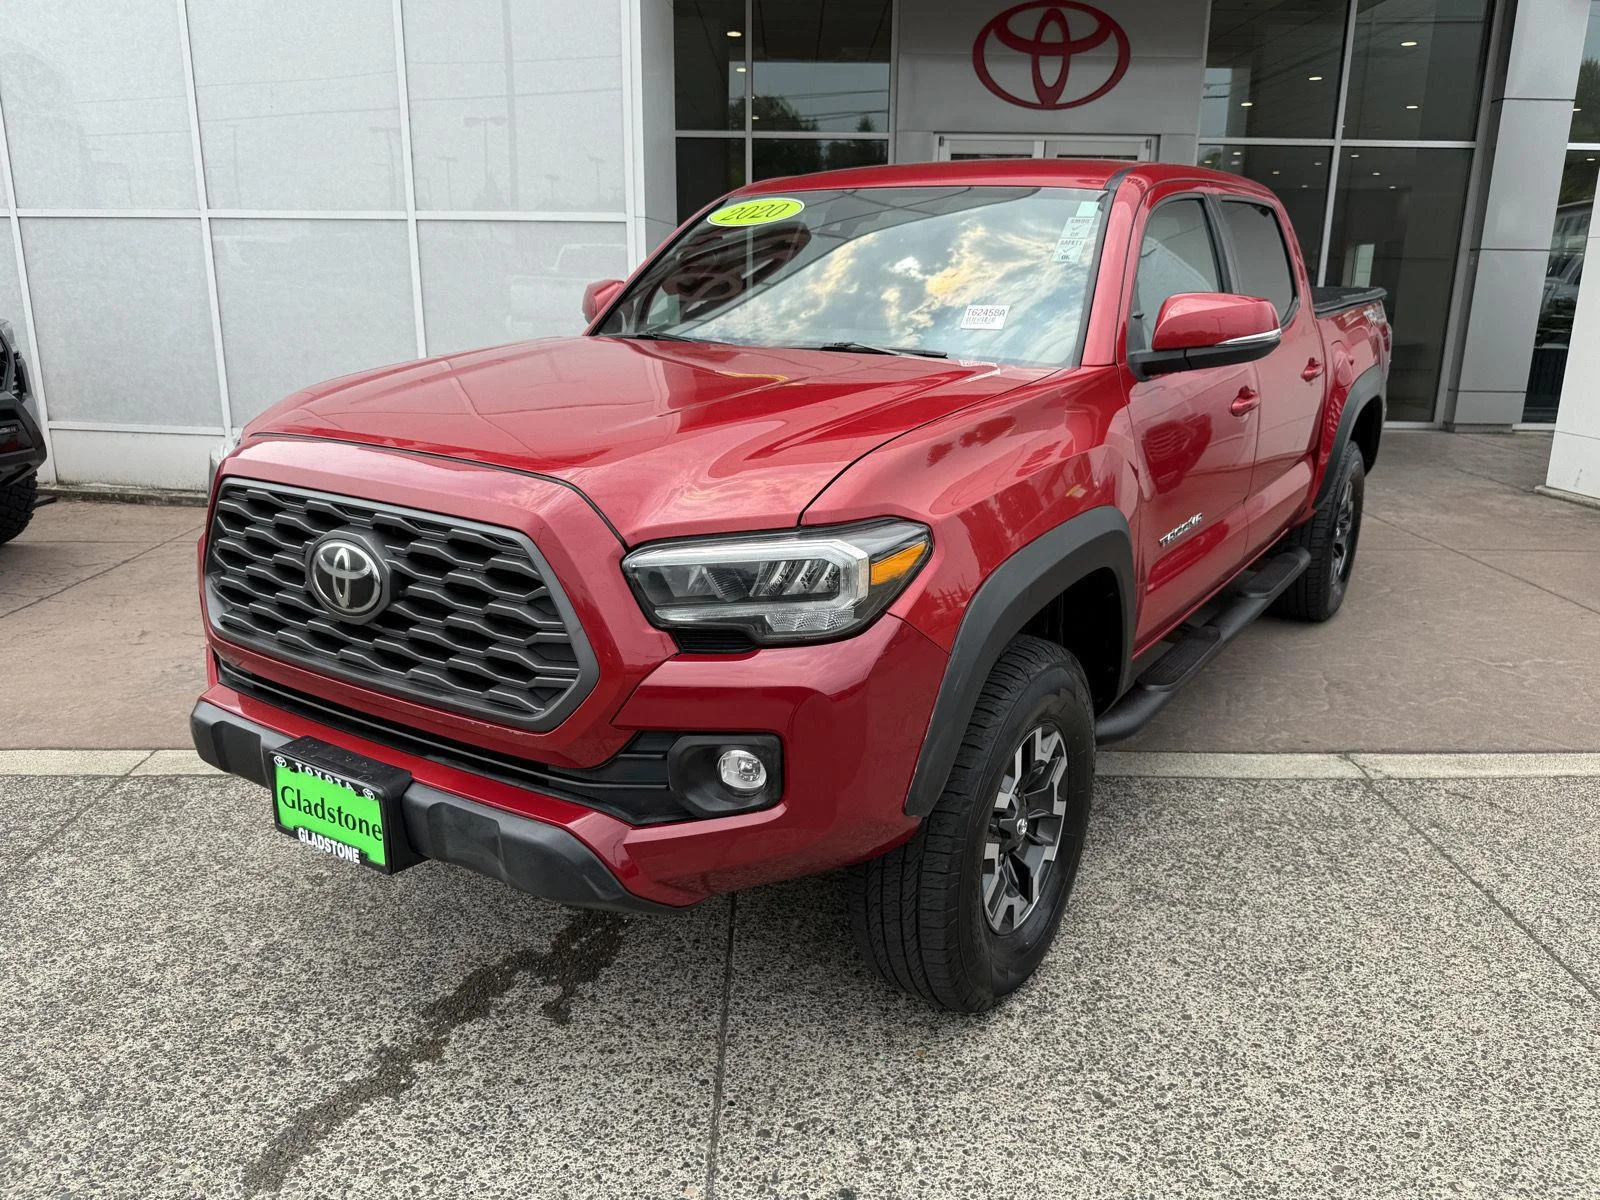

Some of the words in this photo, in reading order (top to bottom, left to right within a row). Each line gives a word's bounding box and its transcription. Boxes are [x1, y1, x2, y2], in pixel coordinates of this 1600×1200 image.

[719, 203, 790, 222] 2020
[294, 762, 355, 792] TOYOTA
[280, 785, 383, 841] Gladstone
[297, 826, 361, 864] GLADSTONE
